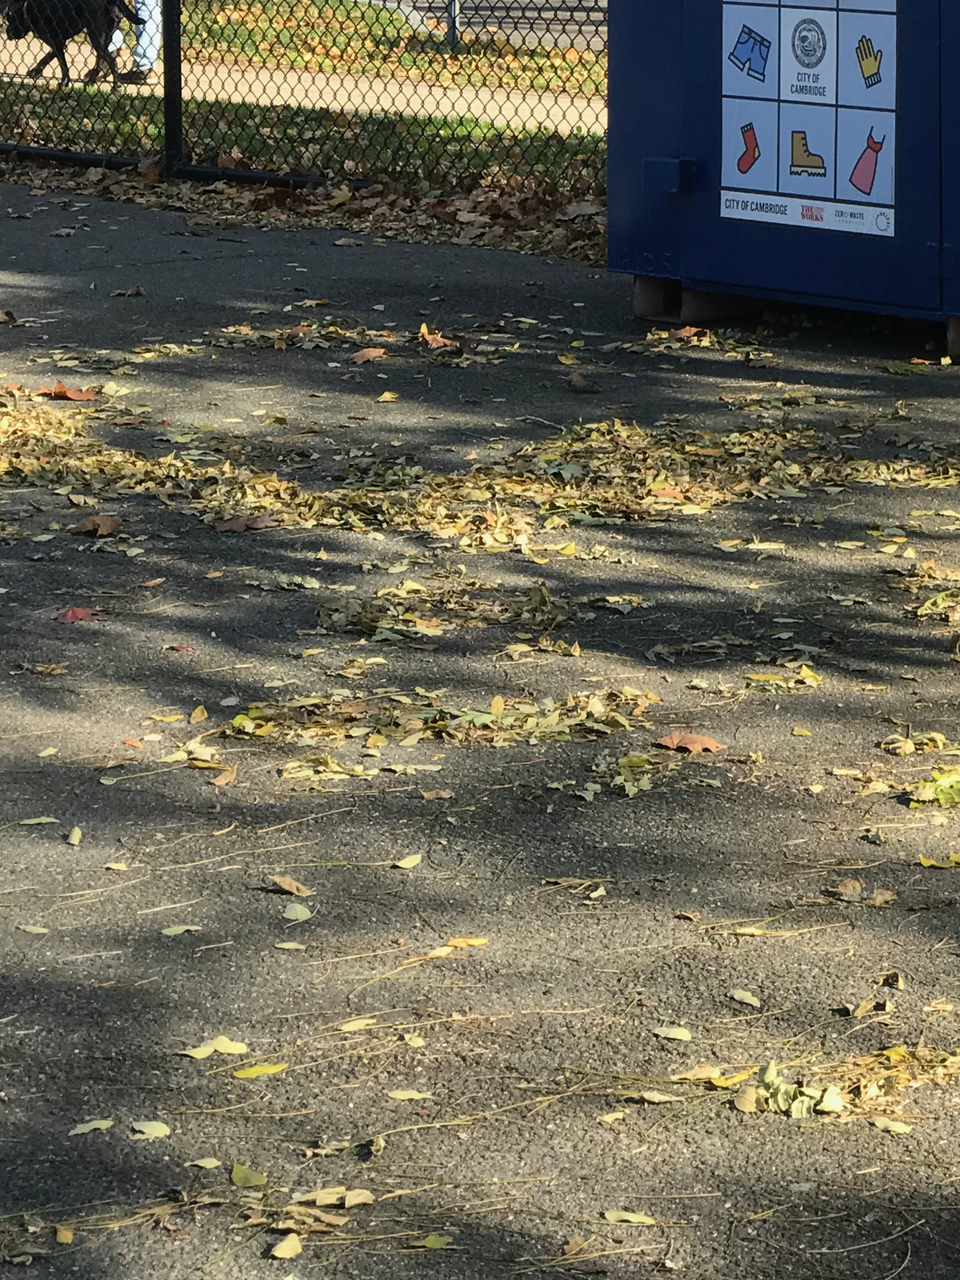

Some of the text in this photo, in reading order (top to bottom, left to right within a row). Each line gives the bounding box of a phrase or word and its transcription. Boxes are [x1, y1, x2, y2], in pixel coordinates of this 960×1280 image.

[797, 72, 820, 83] CITY OF
[790, 84, 827, 97] CAMBRIDGE
[725, 198, 788, 216] CITY OF CAMBRIDGE
